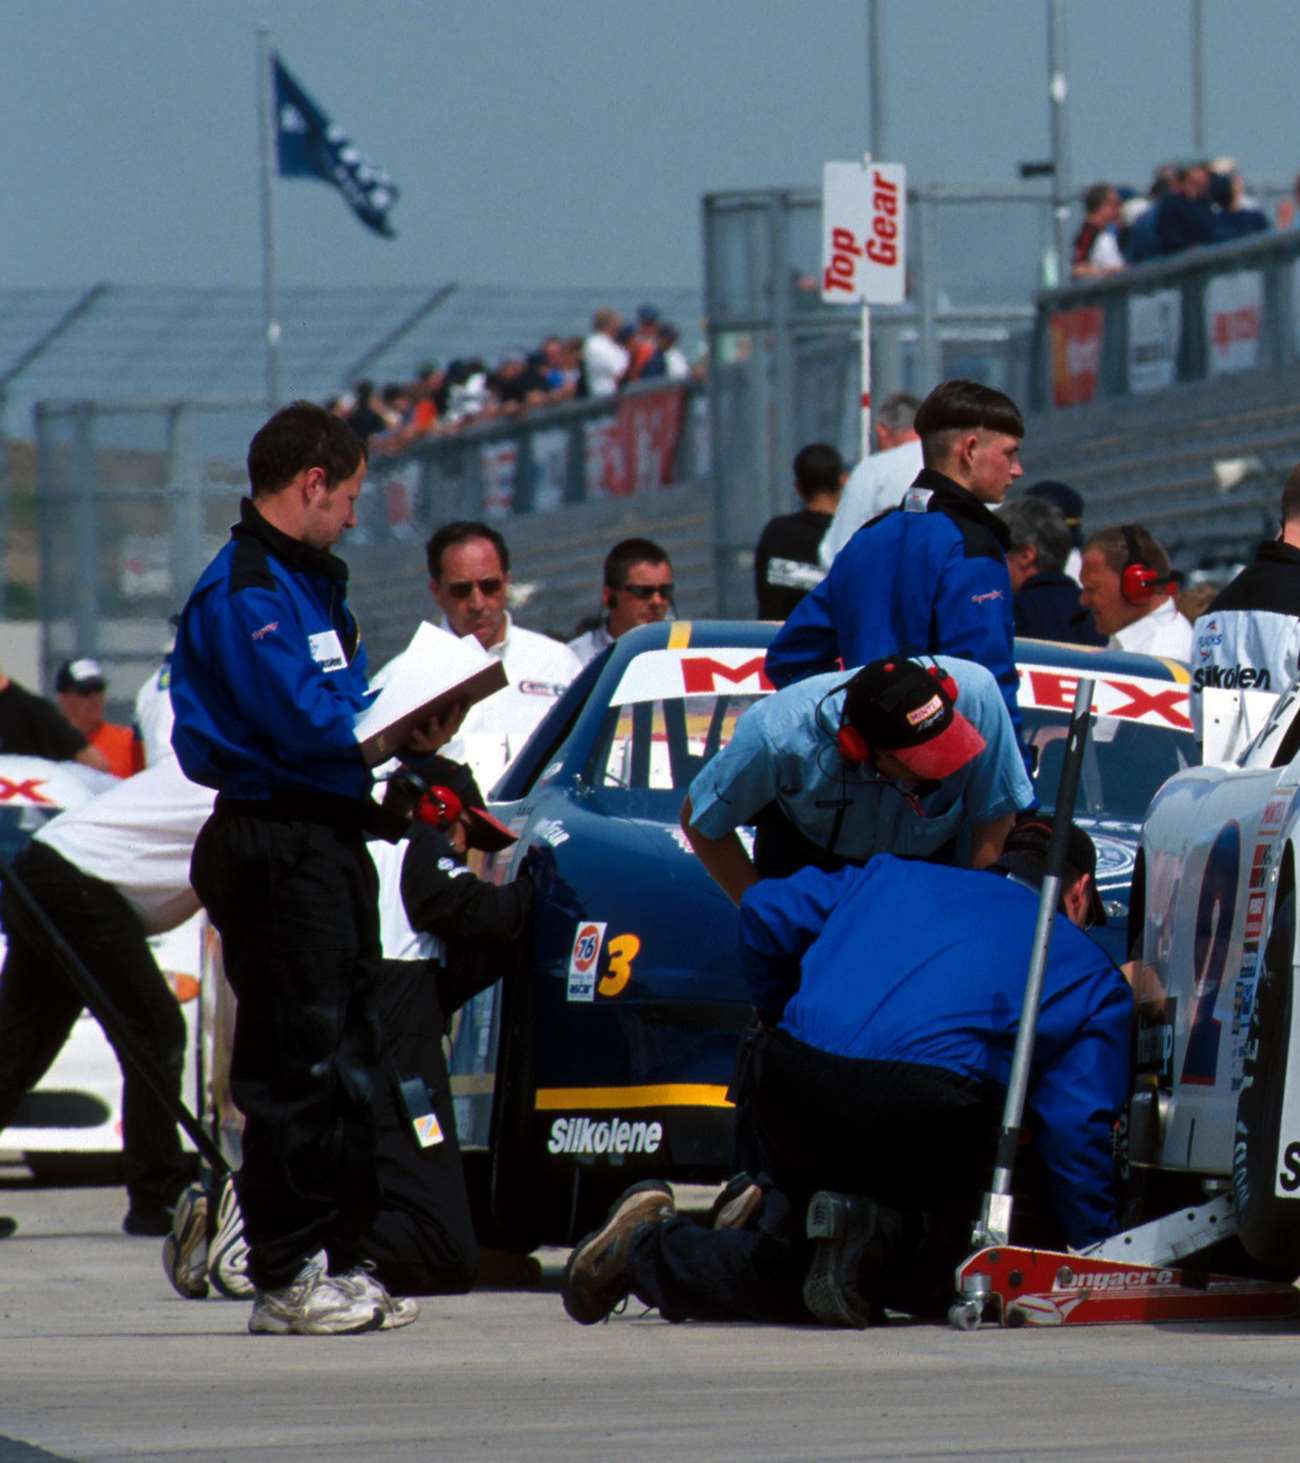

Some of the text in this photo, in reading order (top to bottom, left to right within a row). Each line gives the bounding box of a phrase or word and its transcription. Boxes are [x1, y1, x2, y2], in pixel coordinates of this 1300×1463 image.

[865, 170, 897, 267] Gear
[824, 226, 863, 295] Top
[576, 935, 597, 961] 76
[597, 933, 641, 997] 3
[547, 1117, 663, 1155] Silkolene
